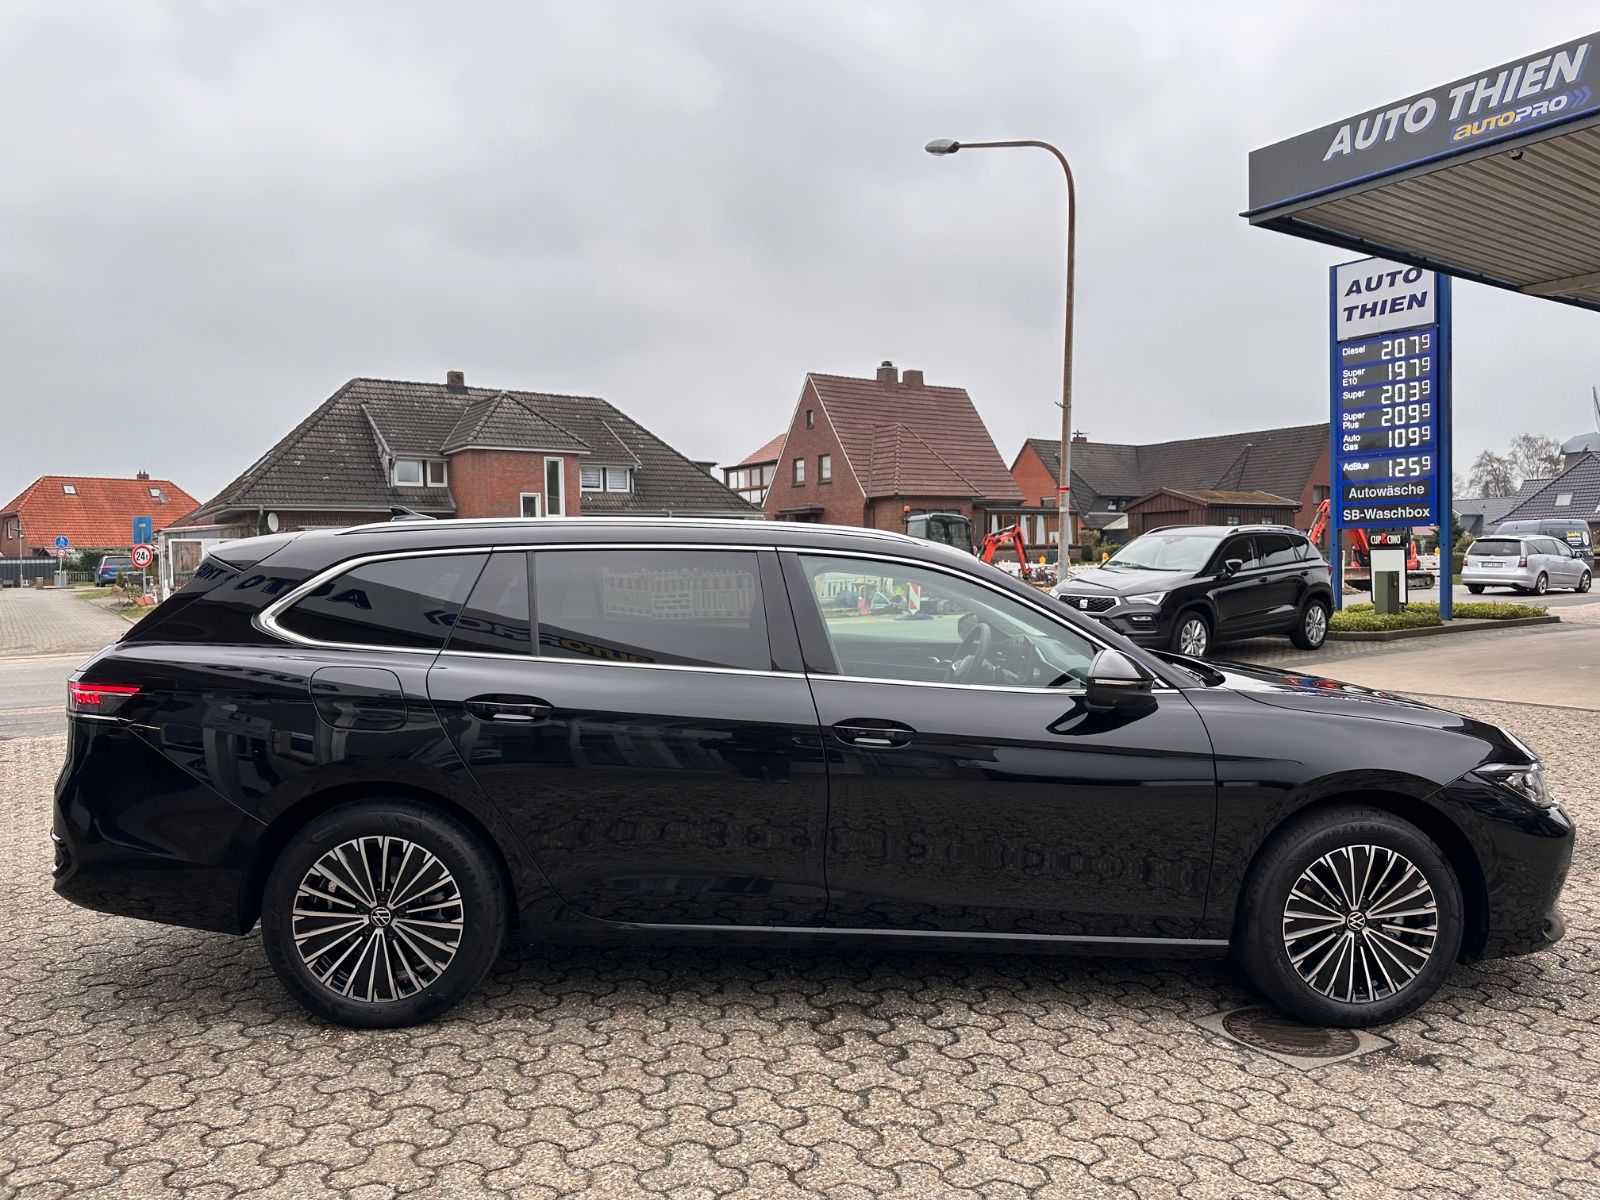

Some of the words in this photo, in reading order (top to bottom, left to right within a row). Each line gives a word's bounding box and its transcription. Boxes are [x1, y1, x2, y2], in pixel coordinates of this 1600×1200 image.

[1322, 97, 1439, 161] AUTO
[1448, 42, 1590, 121] THIEN
[1344, 266, 1423, 297] AUTO
[1343, 290, 1428, 322] THIEN
[1342, 345, 1366, 356] Diesel
[1381, 334, 1430, 360] 2079
[1342, 368, 1366, 378] Super
[1388, 357, 1430, 380] 1979
[1342, 378, 1358, 387] E10
[1342, 390, 1366, 400] Super
[1381, 380, 1430, 405] 2039
[1342, 412, 1366, 422] Super
[1381, 402, 1430, 427] 2099
[1342, 421, 1360, 430] Plus
[1343, 434, 1361, 443] Auto
[1388, 426, 1431, 448] 1099
[1343, 443, 1359, 451] Gas
[1343, 462, 1370, 471] AdBlue
[1388, 456, 1431, 477] 1259
[1348, 484, 1425, 499] Autowäsche
[1343, 506, 1431, 520] SB-Waschbox
